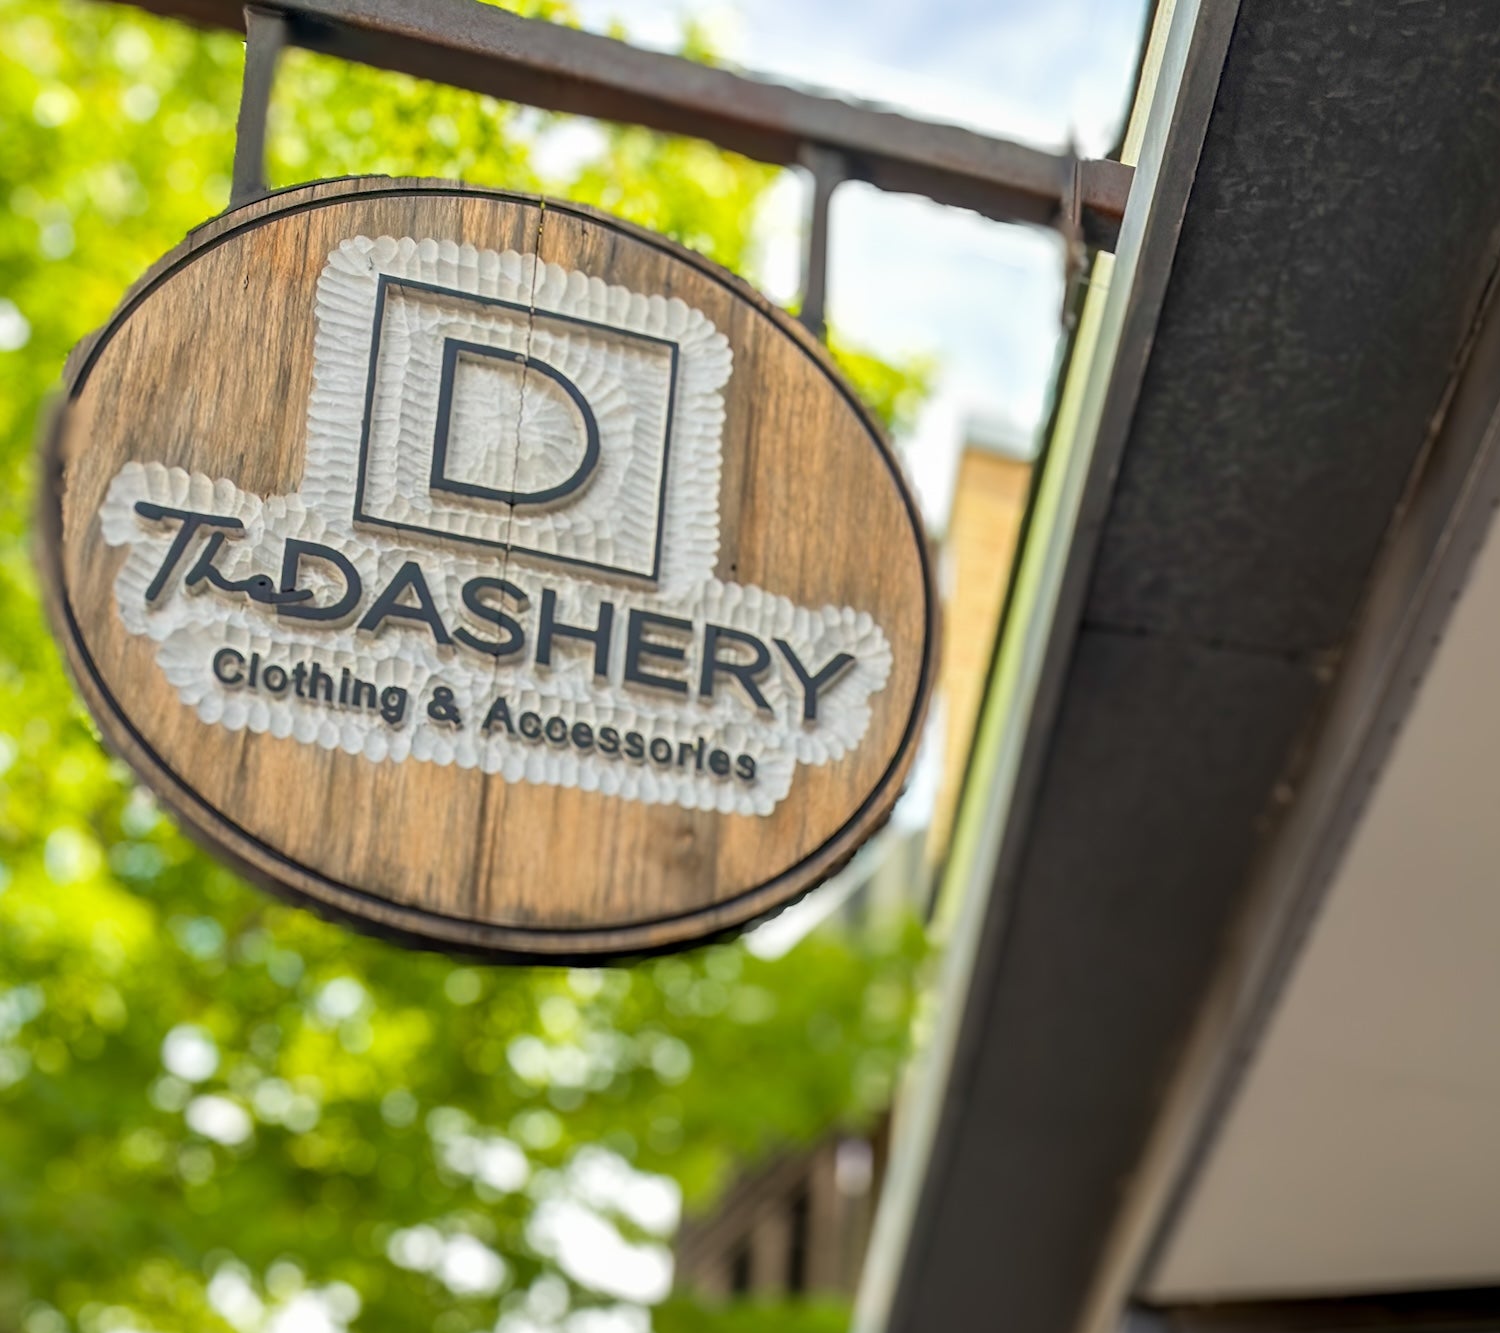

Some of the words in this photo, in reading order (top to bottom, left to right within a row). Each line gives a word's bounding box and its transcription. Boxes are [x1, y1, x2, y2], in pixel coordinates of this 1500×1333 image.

[431, 337, 601, 507] D
[134, 501, 314, 604] The
[277, 537, 857, 721] DASHERY
[212, 647, 408, 727] Clothing
[426, 685, 462, 730] &
[481, 696, 758, 783] Accessories
